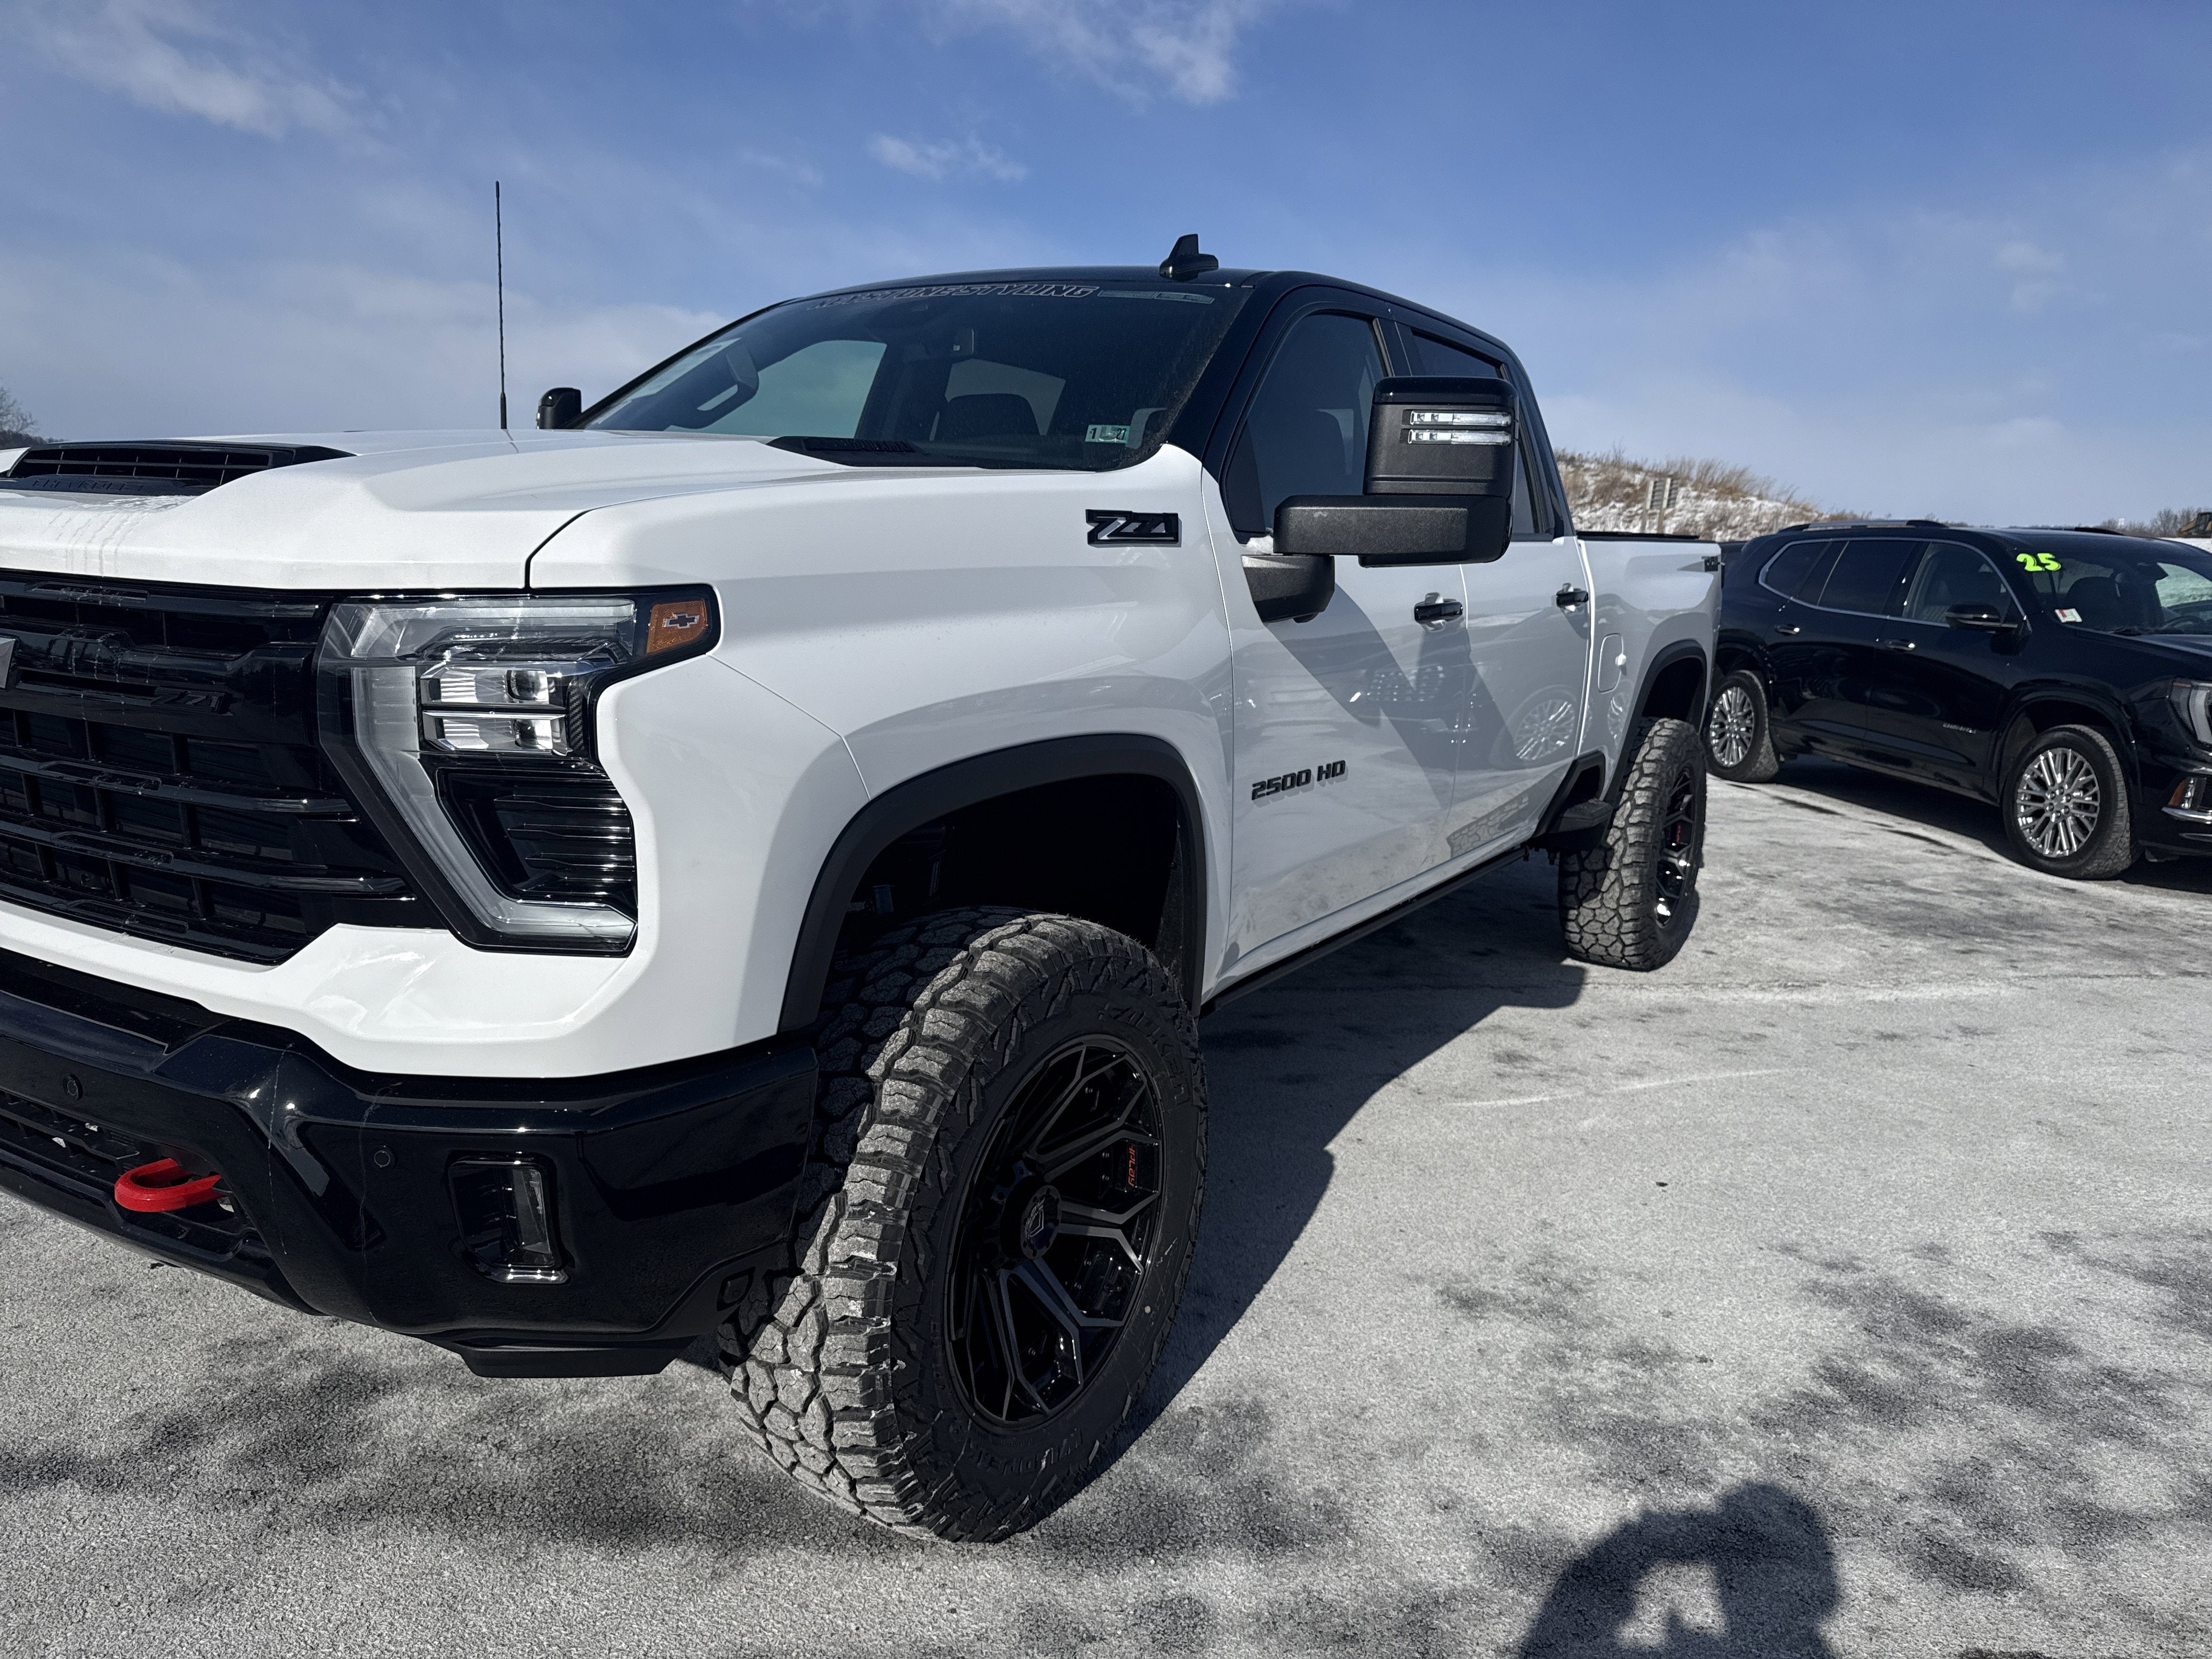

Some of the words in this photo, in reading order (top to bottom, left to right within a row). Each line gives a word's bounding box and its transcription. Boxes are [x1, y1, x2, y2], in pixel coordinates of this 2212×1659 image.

[1116, 428, 1127, 440] 27
[2016, 552, 2062, 572] 25
[1251, 768, 1312, 800] 2500
[1317, 760, 1346, 782] HD
